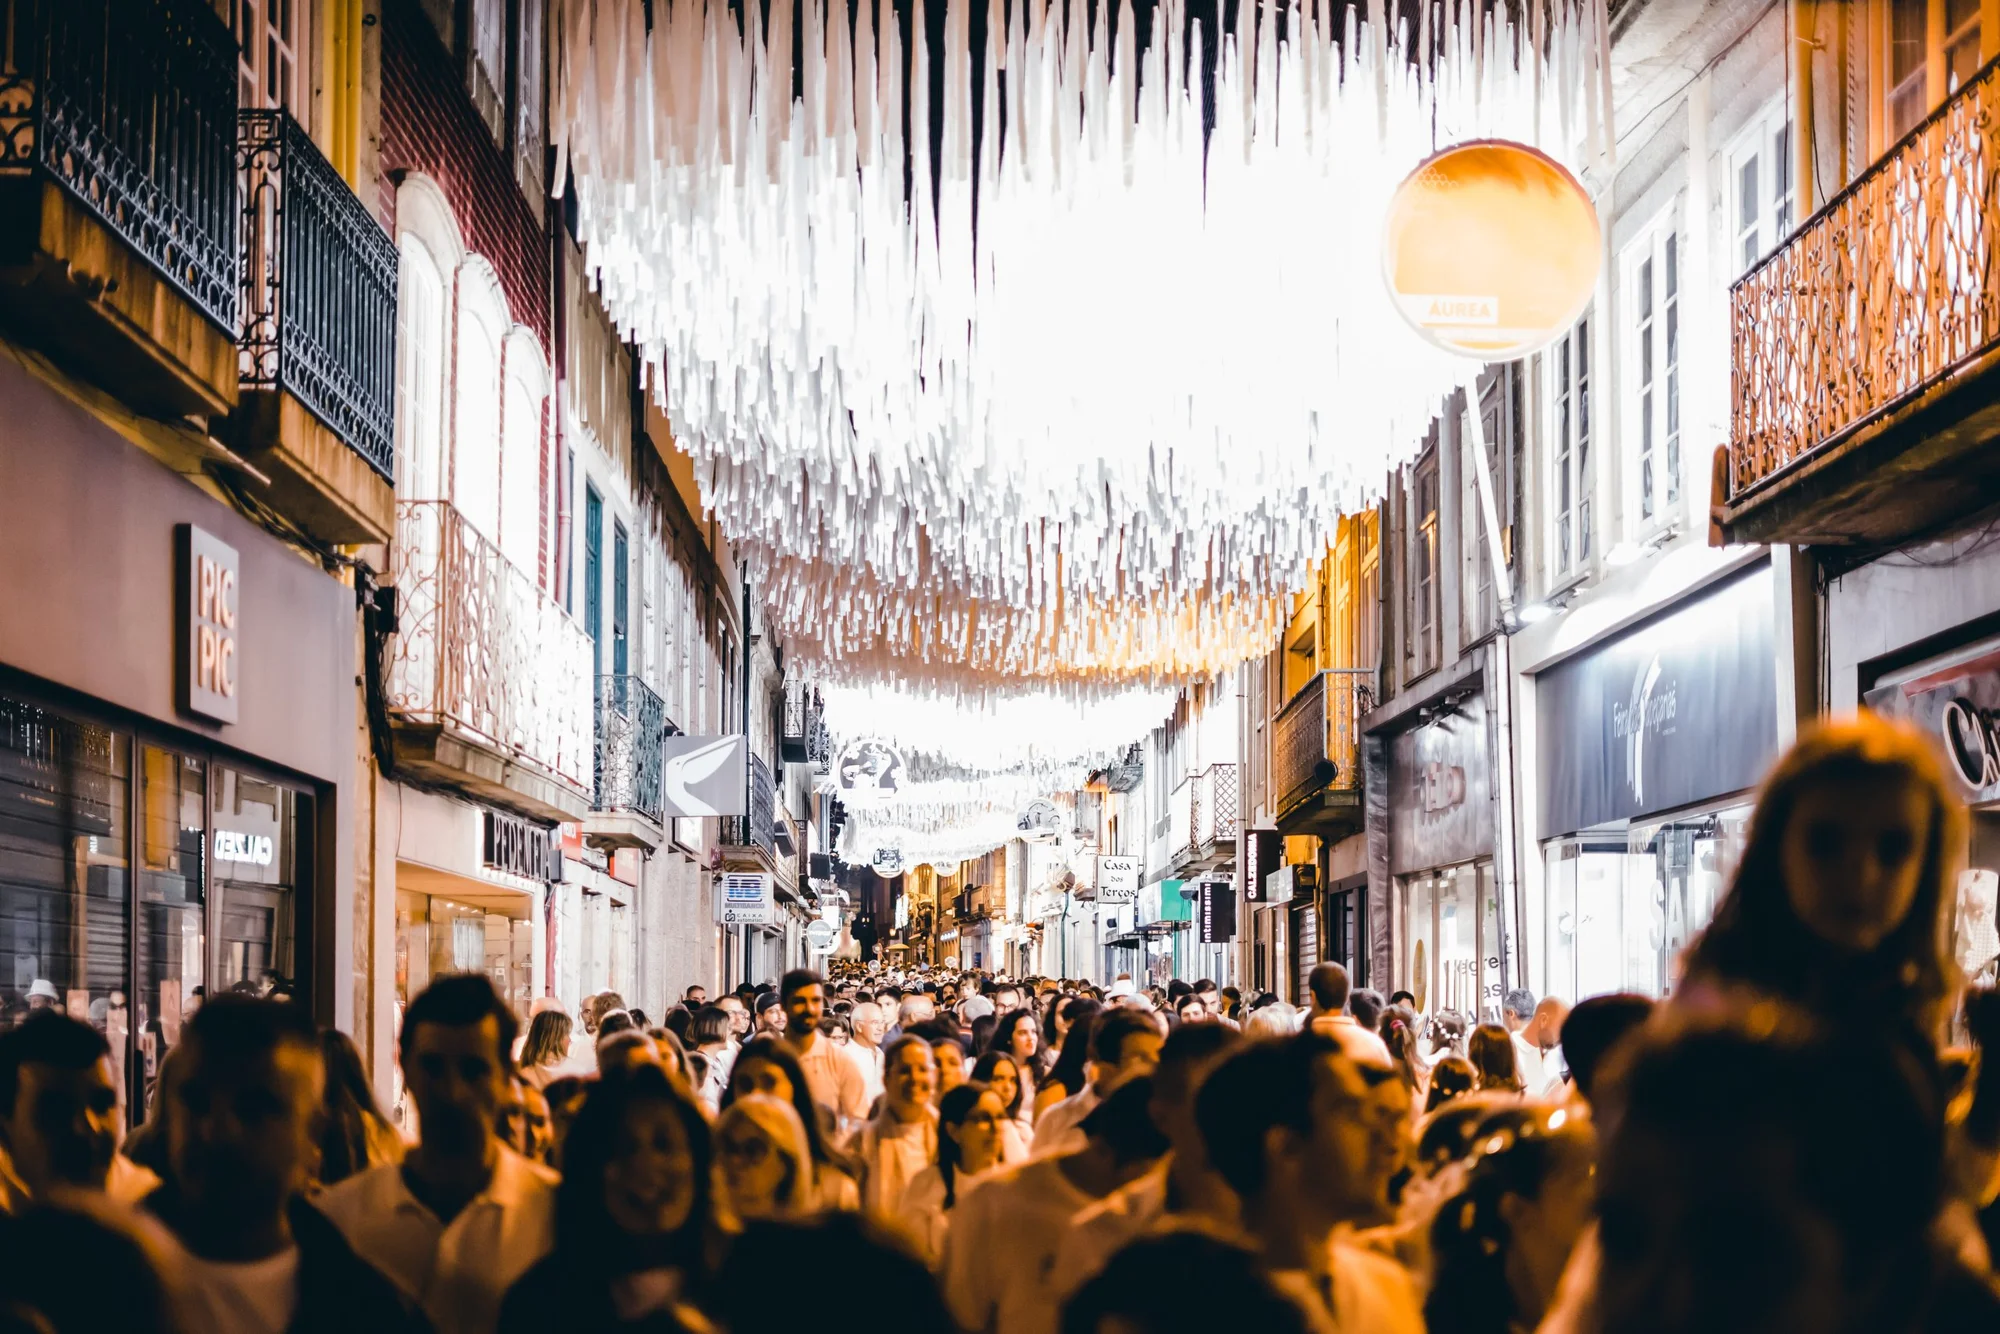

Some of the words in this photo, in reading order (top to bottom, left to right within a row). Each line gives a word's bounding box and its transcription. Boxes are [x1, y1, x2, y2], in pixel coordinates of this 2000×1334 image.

[198, 554, 235, 629] PIC
[198, 624, 235, 698] PIC
[1100, 886, 1136, 899] Terços
[1104, 859, 1131, 870] Casa
[1110, 875, 1124, 883] dos
[1247, 833, 1258, 899] CALZEDONIA
[1203, 883, 1212, 943] intimissimi
